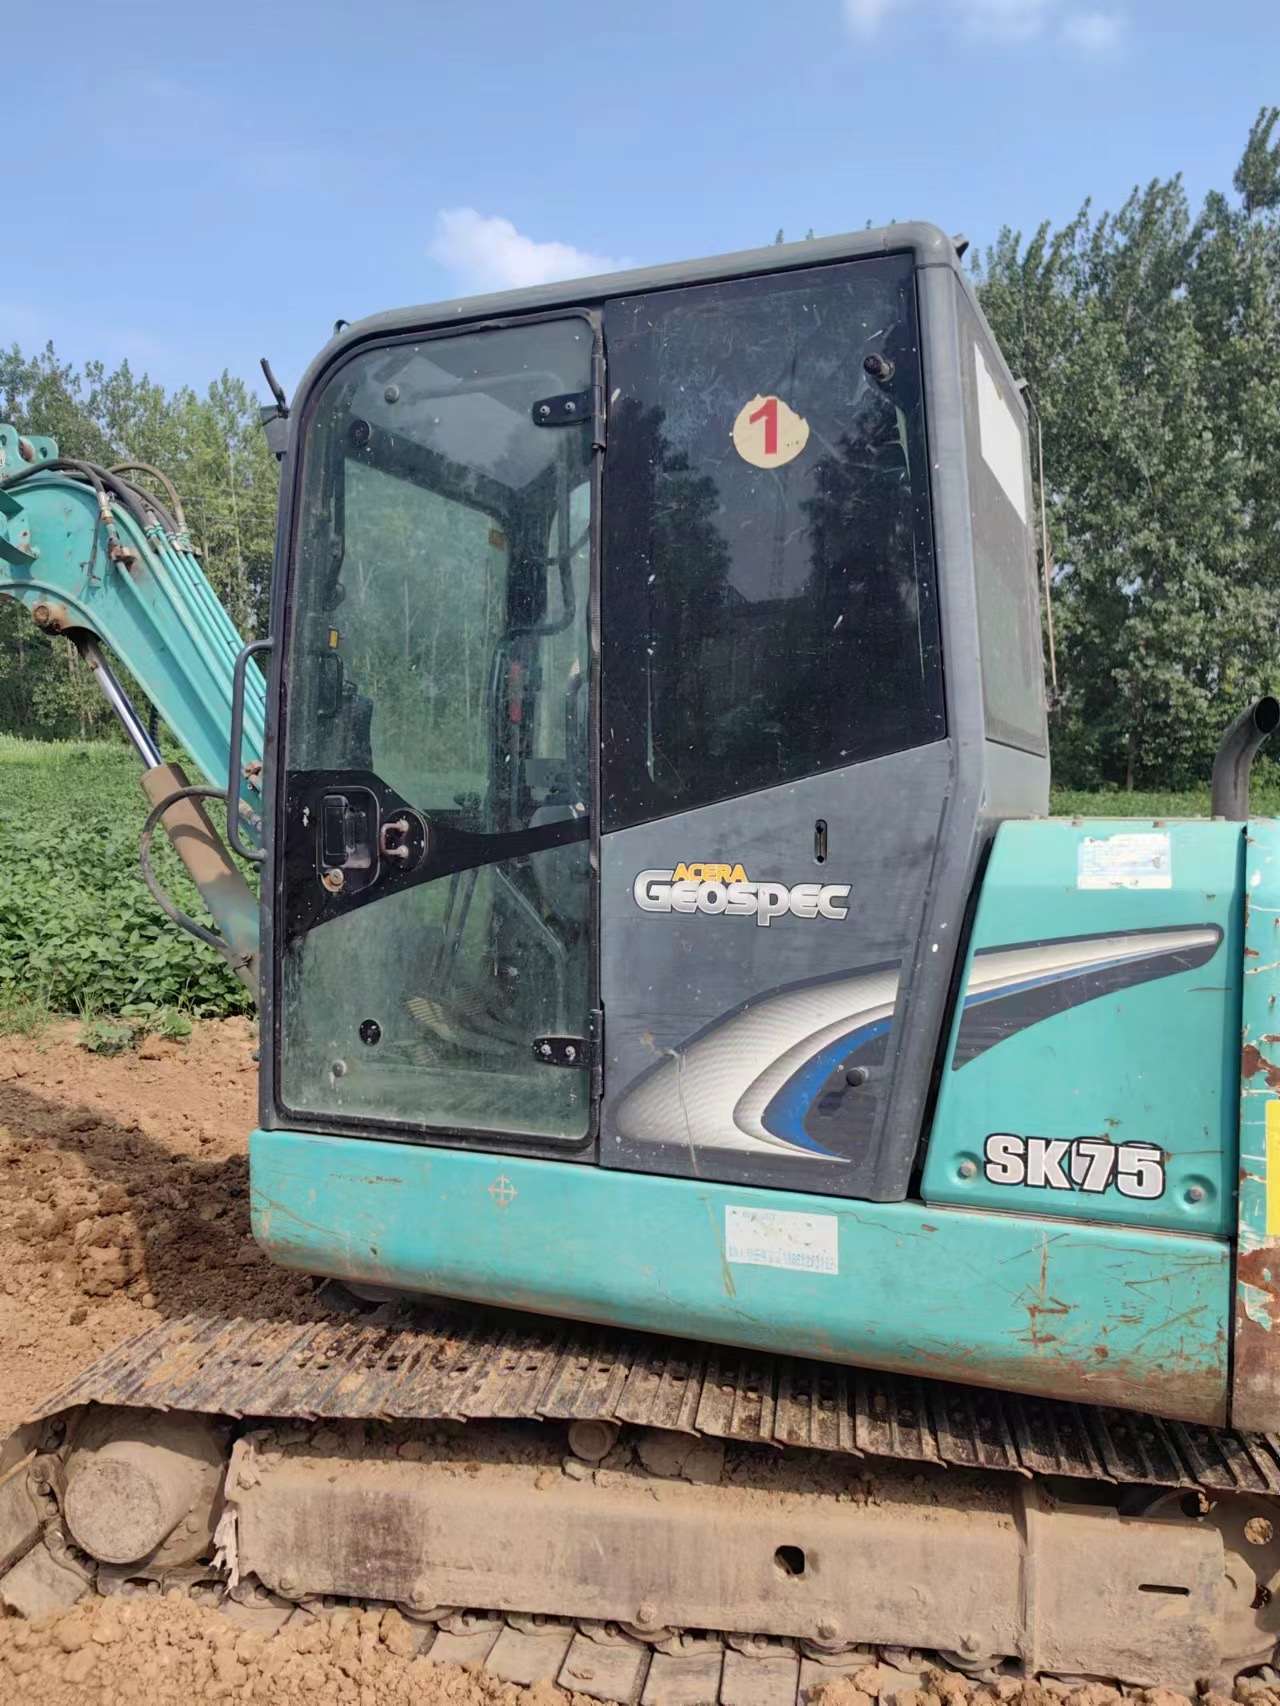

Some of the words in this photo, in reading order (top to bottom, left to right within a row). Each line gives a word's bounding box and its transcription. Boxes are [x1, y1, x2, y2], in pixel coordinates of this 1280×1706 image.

[749, 398, 778, 455] 1
[671, 862, 749, 883] ACERA
[984, 1133, 1166, 1200] SK75
